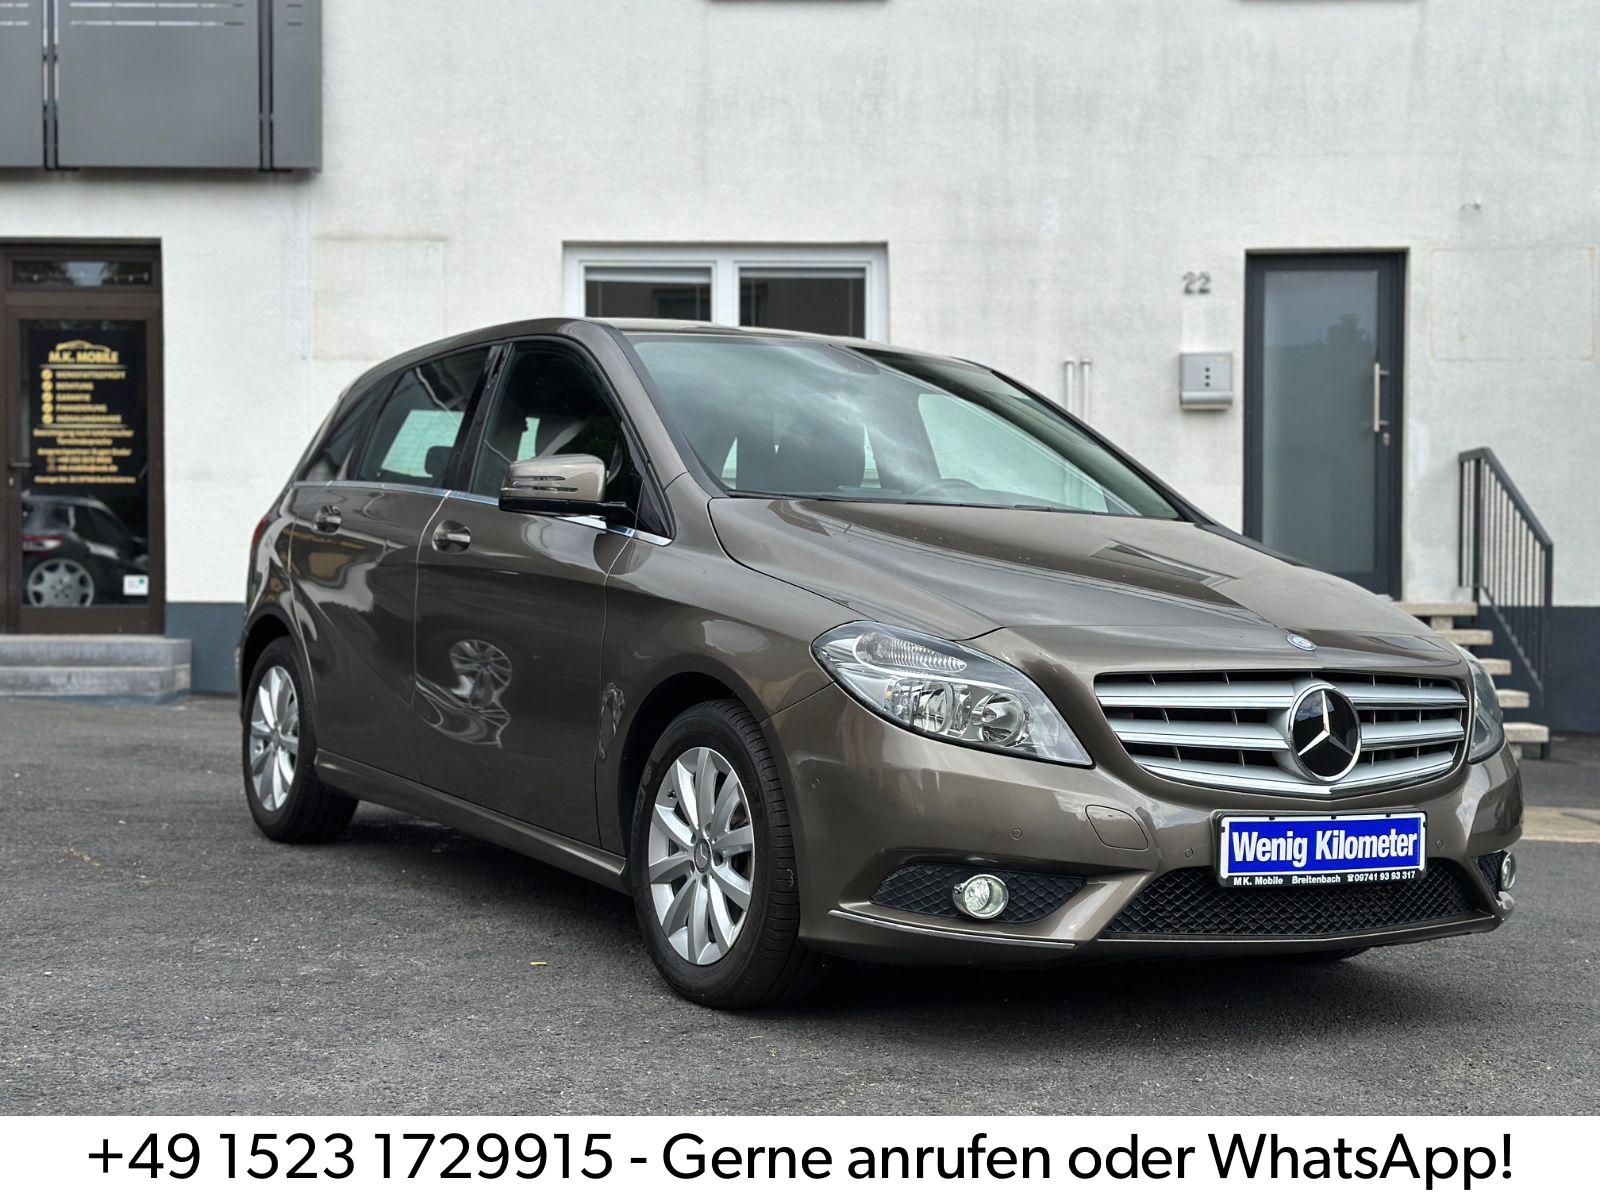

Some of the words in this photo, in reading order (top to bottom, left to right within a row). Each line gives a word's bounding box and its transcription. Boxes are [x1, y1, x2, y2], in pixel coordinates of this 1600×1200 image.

[1182, 271, 1210, 295] 22
[77, 351, 119, 363] MOBILE
[1232, 830, 1308, 868] Wenig
[1315, 828, 1418, 861] Kilometer
[1254, 875, 1284, 885] Mobile
[1291, 874, 1341, 884] Breitenbach
